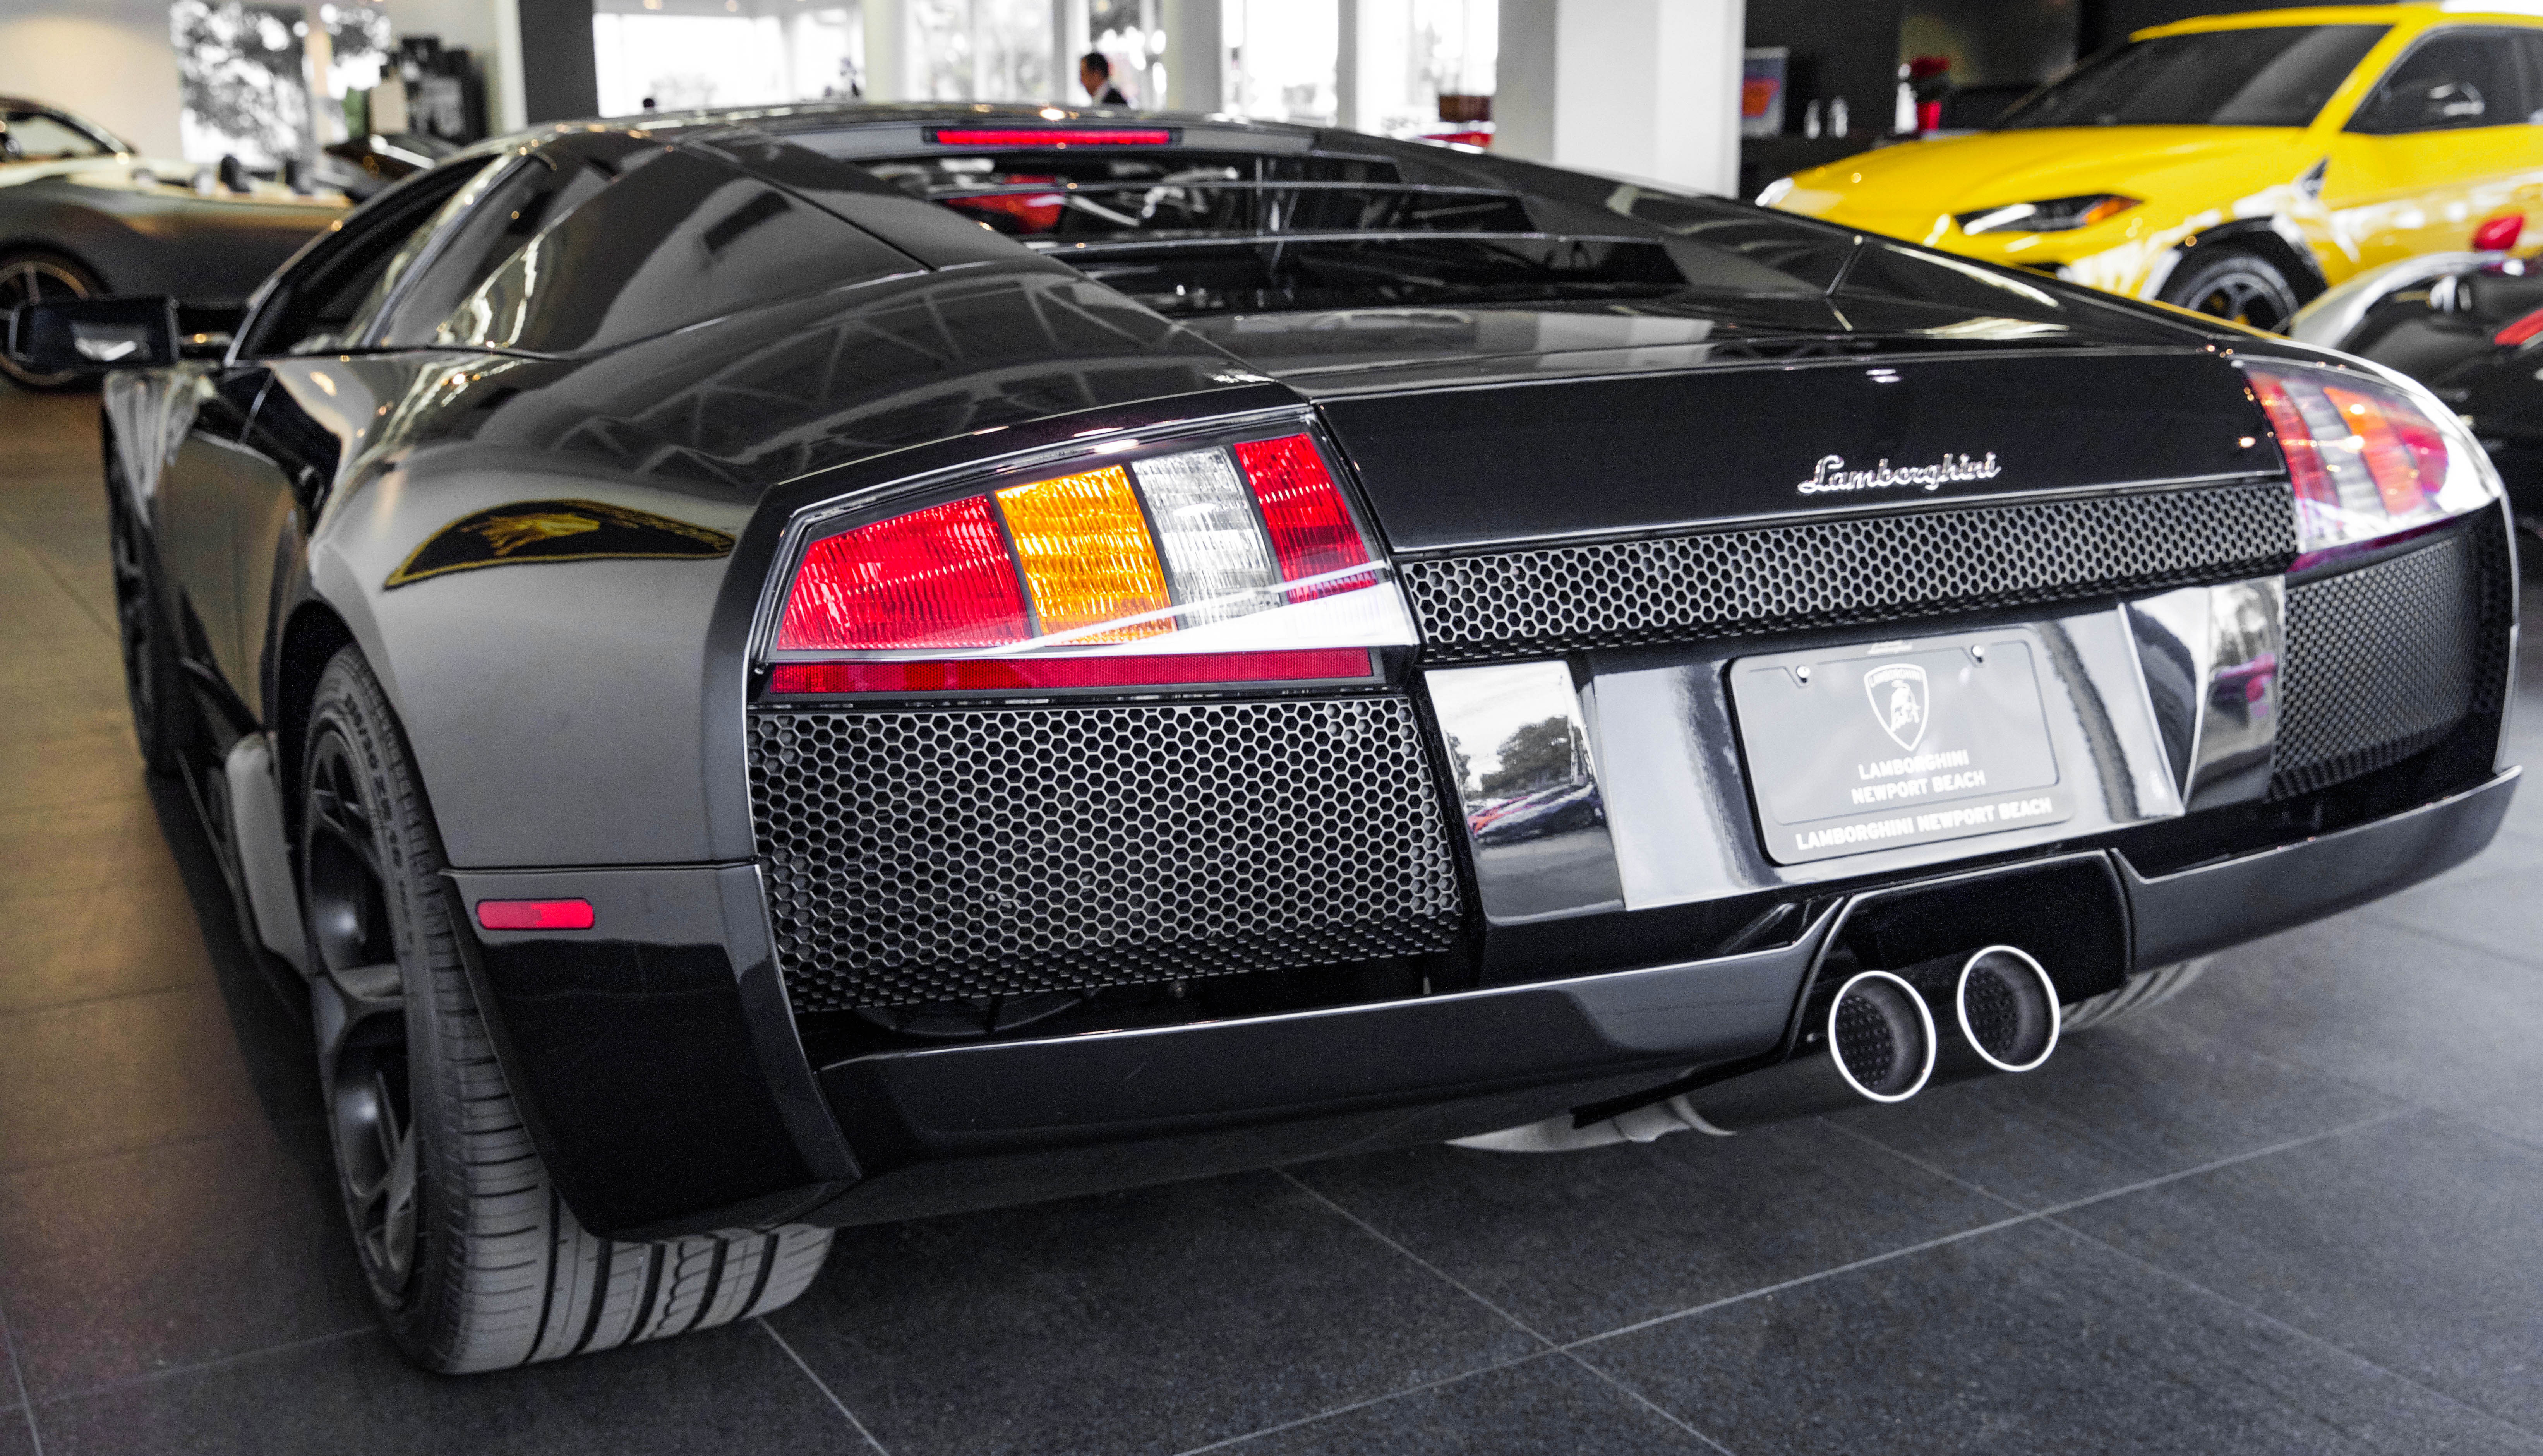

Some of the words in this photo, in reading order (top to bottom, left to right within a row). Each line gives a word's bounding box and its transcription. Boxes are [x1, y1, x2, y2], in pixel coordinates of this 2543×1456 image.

[1797, 452, 2001, 495] Lamborghini
[1858, 749, 1969, 780] LAMBORGHINI
[1851, 778, 1928, 804] NEWPORT
[1932, 769, 1986, 793] BEACH
[1795, 817, 1915, 850] LAMBORGHINI
[1916, 805, 1995, 832] NEWPORT
[1997, 797, 2053, 820] BEACH
